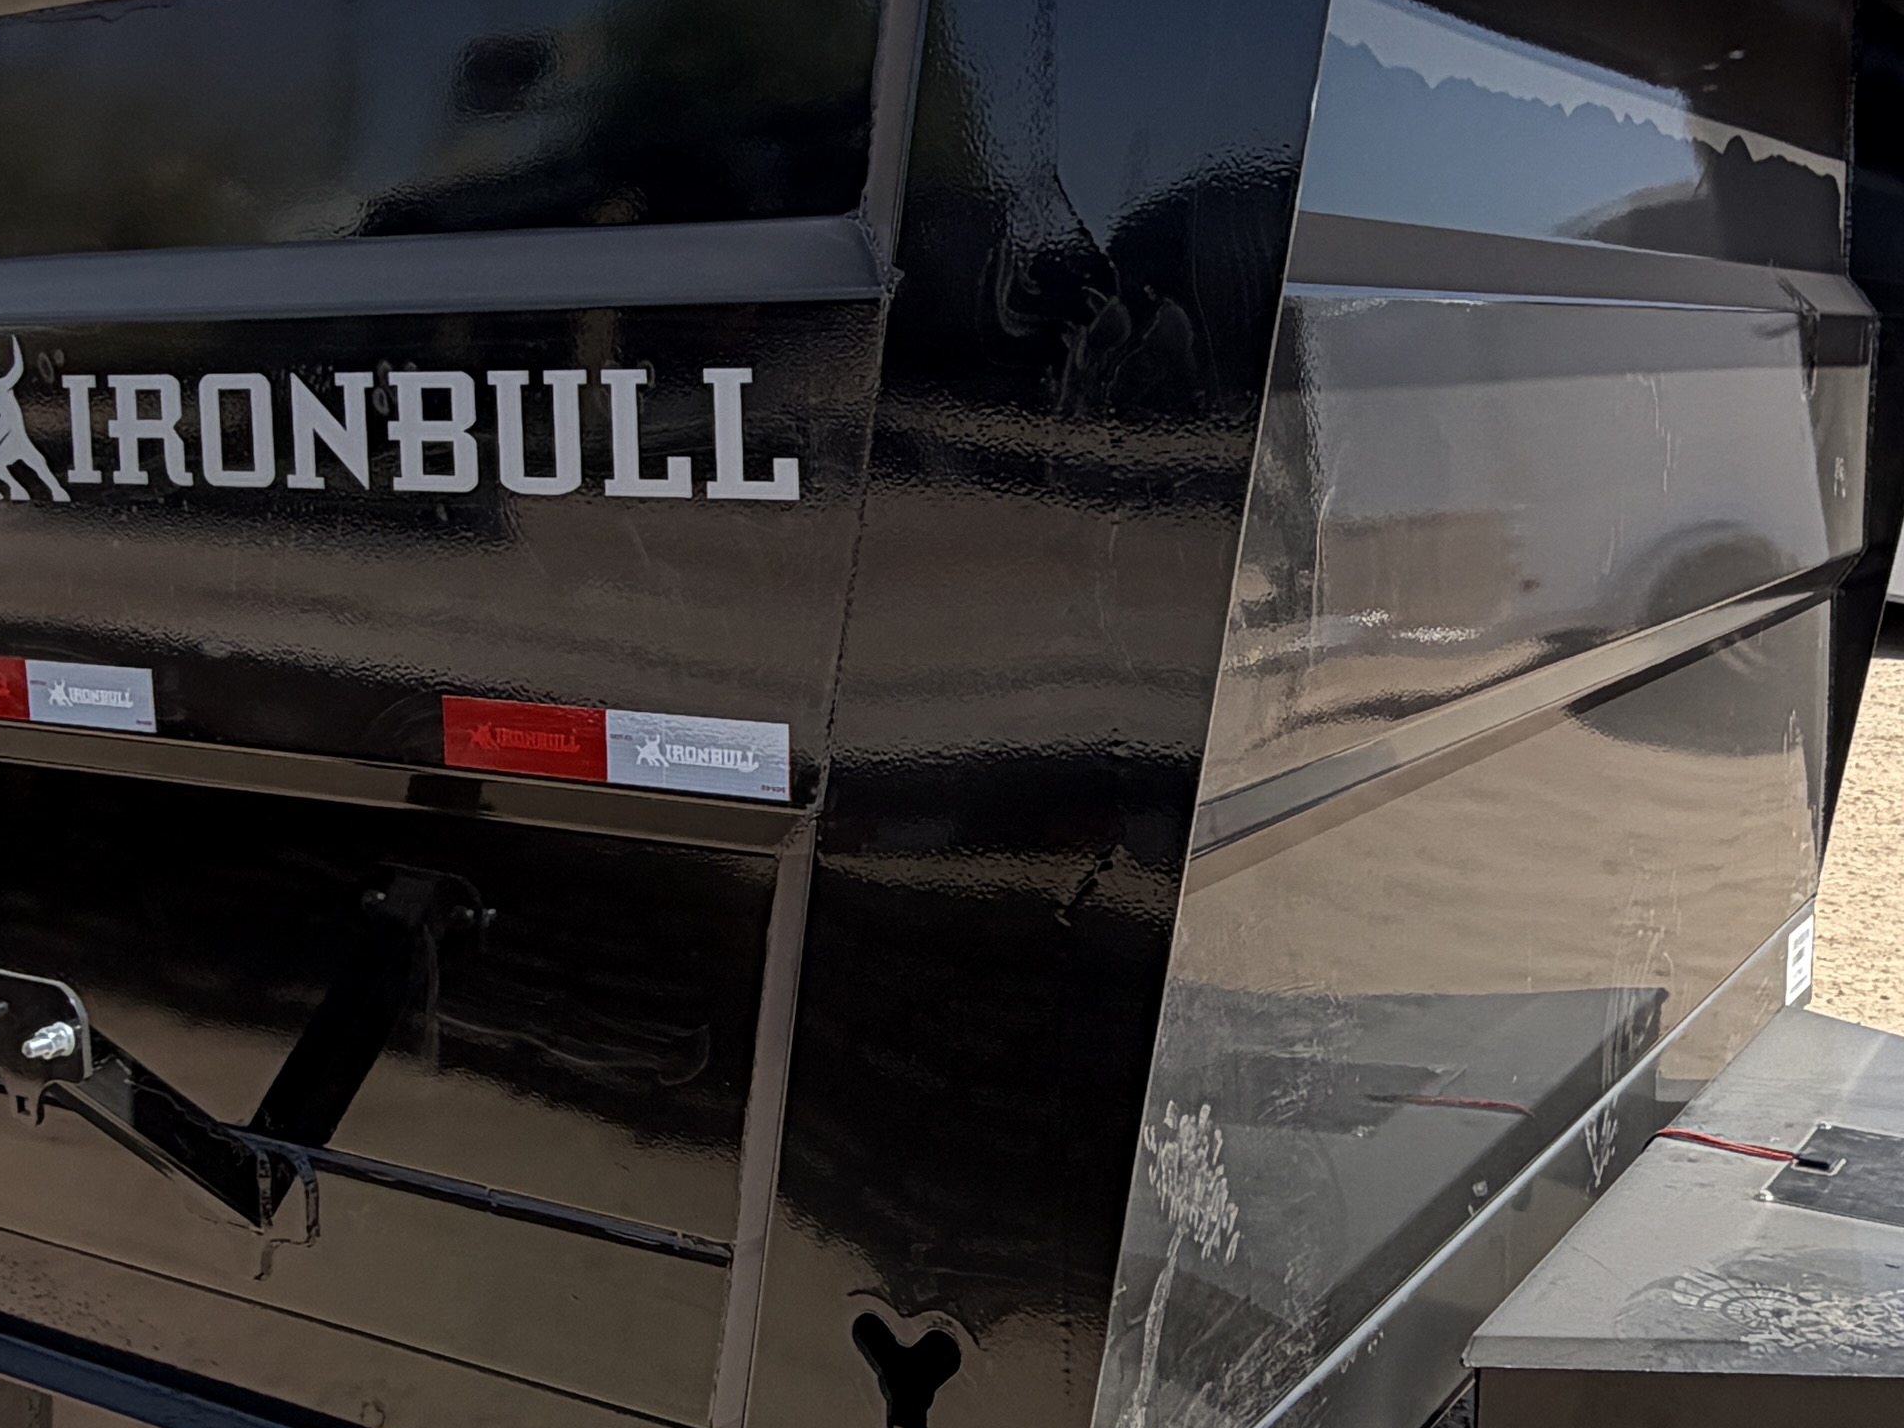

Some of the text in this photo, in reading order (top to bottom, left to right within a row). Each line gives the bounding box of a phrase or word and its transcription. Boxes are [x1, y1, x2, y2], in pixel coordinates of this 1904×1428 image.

[61, 367, 801, 501] IRONBULL
[67, 686, 135, 709] IRONBULL
[664, 742, 761, 773] IRONBULL
